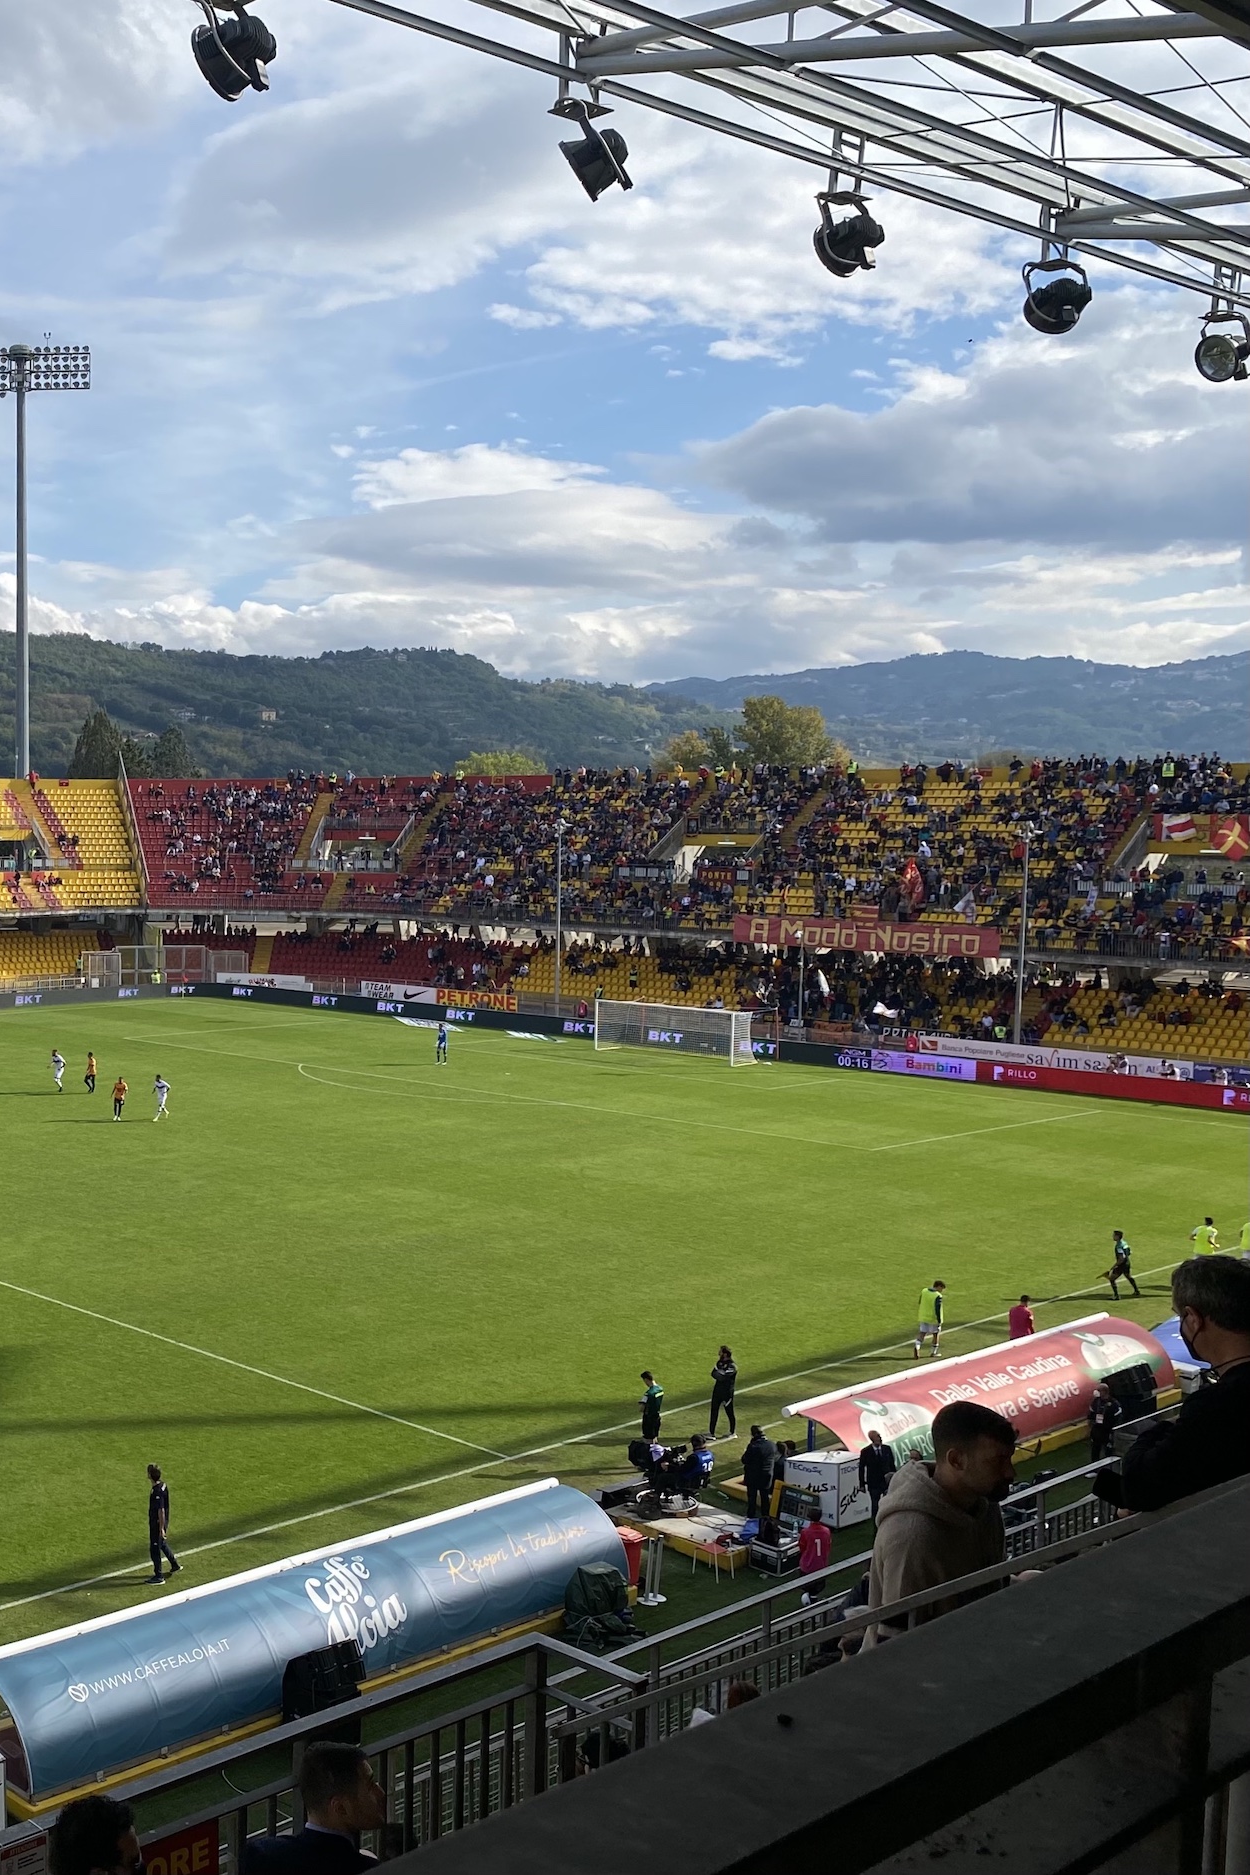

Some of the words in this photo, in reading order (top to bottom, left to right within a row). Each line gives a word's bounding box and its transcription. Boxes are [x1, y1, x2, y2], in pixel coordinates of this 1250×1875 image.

[702, 871, 731, 880] PONTE
[750, 919, 769, 942] A
[870, 926, 981, 955] Nostro
[118, 988, 139, 997] BKT
[171, 986, 195, 994] BKT
[233, 987, 253, 997] BKT
[370, 983, 392, 991] TEAM
[15, 994, 43, 1006] BKT
[312, 995, 338, 1006] BKT
[372, 991, 394, 999] WEAR
[436, 989, 517, 1012] PETRONE
[377, 1001, 404, 1013] BKT
[446, 1009, 476, 1021] BKT
[563, 1021, 595, 1034] BKT
[648, 1030, 684, 1044] BKT
[740, 1040, 777, 1055] BKT
[838, 1056, 869, 1069] 00:16
[906, 1058, 963, 1075] Bambini
[1007, 1068, 1037, 1079] RILLO
[928, 1383, 979, 1406] Dalla
[967, 1371, 1013, 1392] Valle
[1006, 1354, 1072, 1381] Caudina
[1019, 1399, 1029, 1413] e
[1026, 1380, 1080, 1408] Sapore
[814, 1539, 822, 1557] 1
[439, 1549, 509, 1586] Riscopri
[507, 1533, 527, 1558] la
[88, 1638, 231, 1695] WWW.CAFFEALOIA.IT
